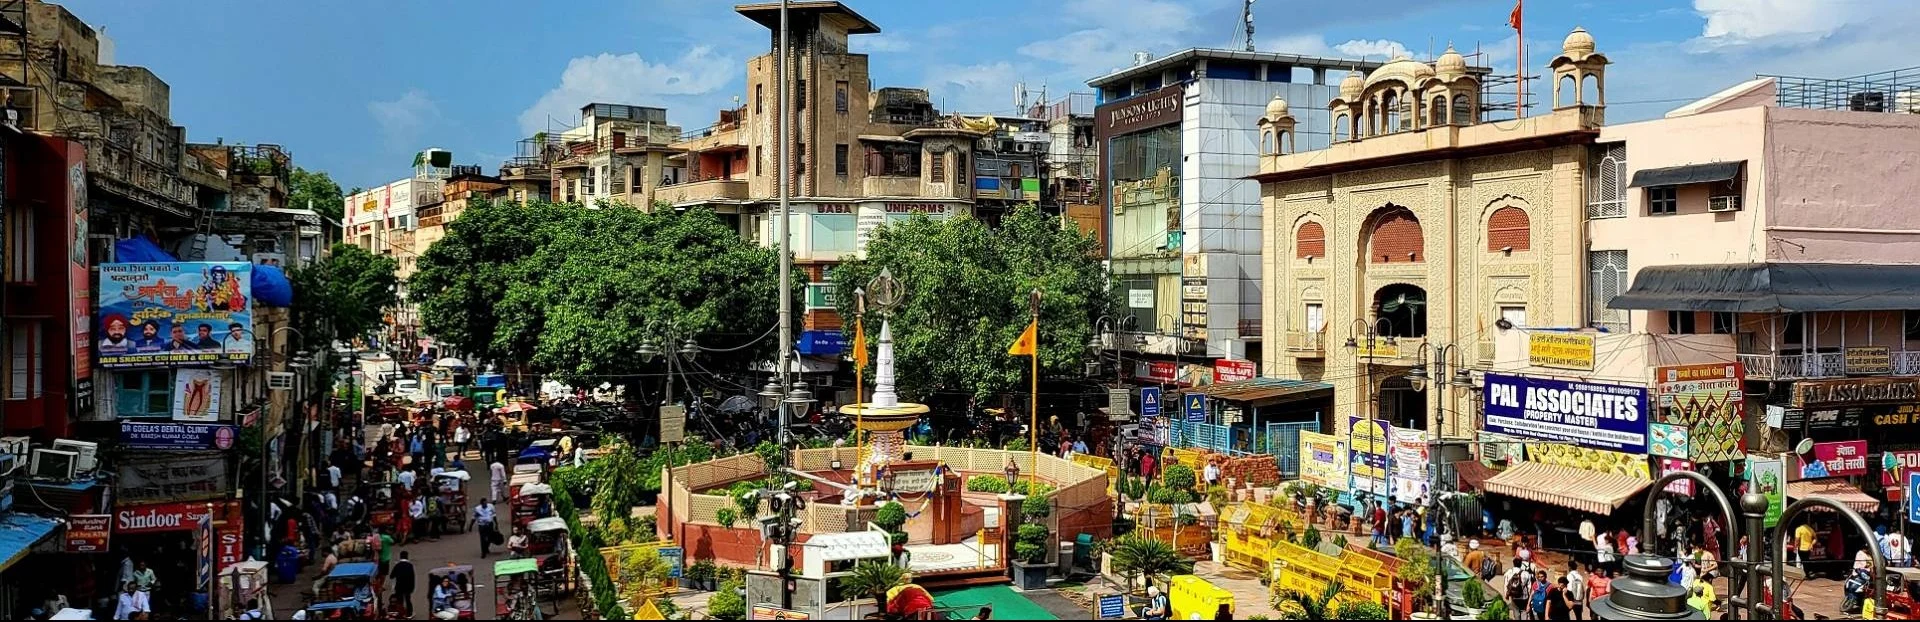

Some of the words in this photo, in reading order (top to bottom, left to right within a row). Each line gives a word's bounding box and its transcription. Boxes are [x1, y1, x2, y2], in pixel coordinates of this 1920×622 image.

[817, 204, 852, 213] BABA
[885, 203, 945, 213] UNIFORMS
[118, 355, 153, 363] SNACKS
[1566, 358, 1590, 367] MUSEUM
[1490, 383, 1519, 408] PAL
[1525, 386, 1639, 422] ASSOCIATES
[1523, 409, 1563, 422] (PROPERTY
[1564, 415, 1598, 429] MASTER)
[1873, 414, 1908, 426] CASH
[1911, 413, 1920, 424] F
[121, 424, 131, 432] DR
[161, 425, 186, 433] DENTAL
[187, 425, 209, 434] CLINIC
[118, 510, 182, 530] Sindoor
